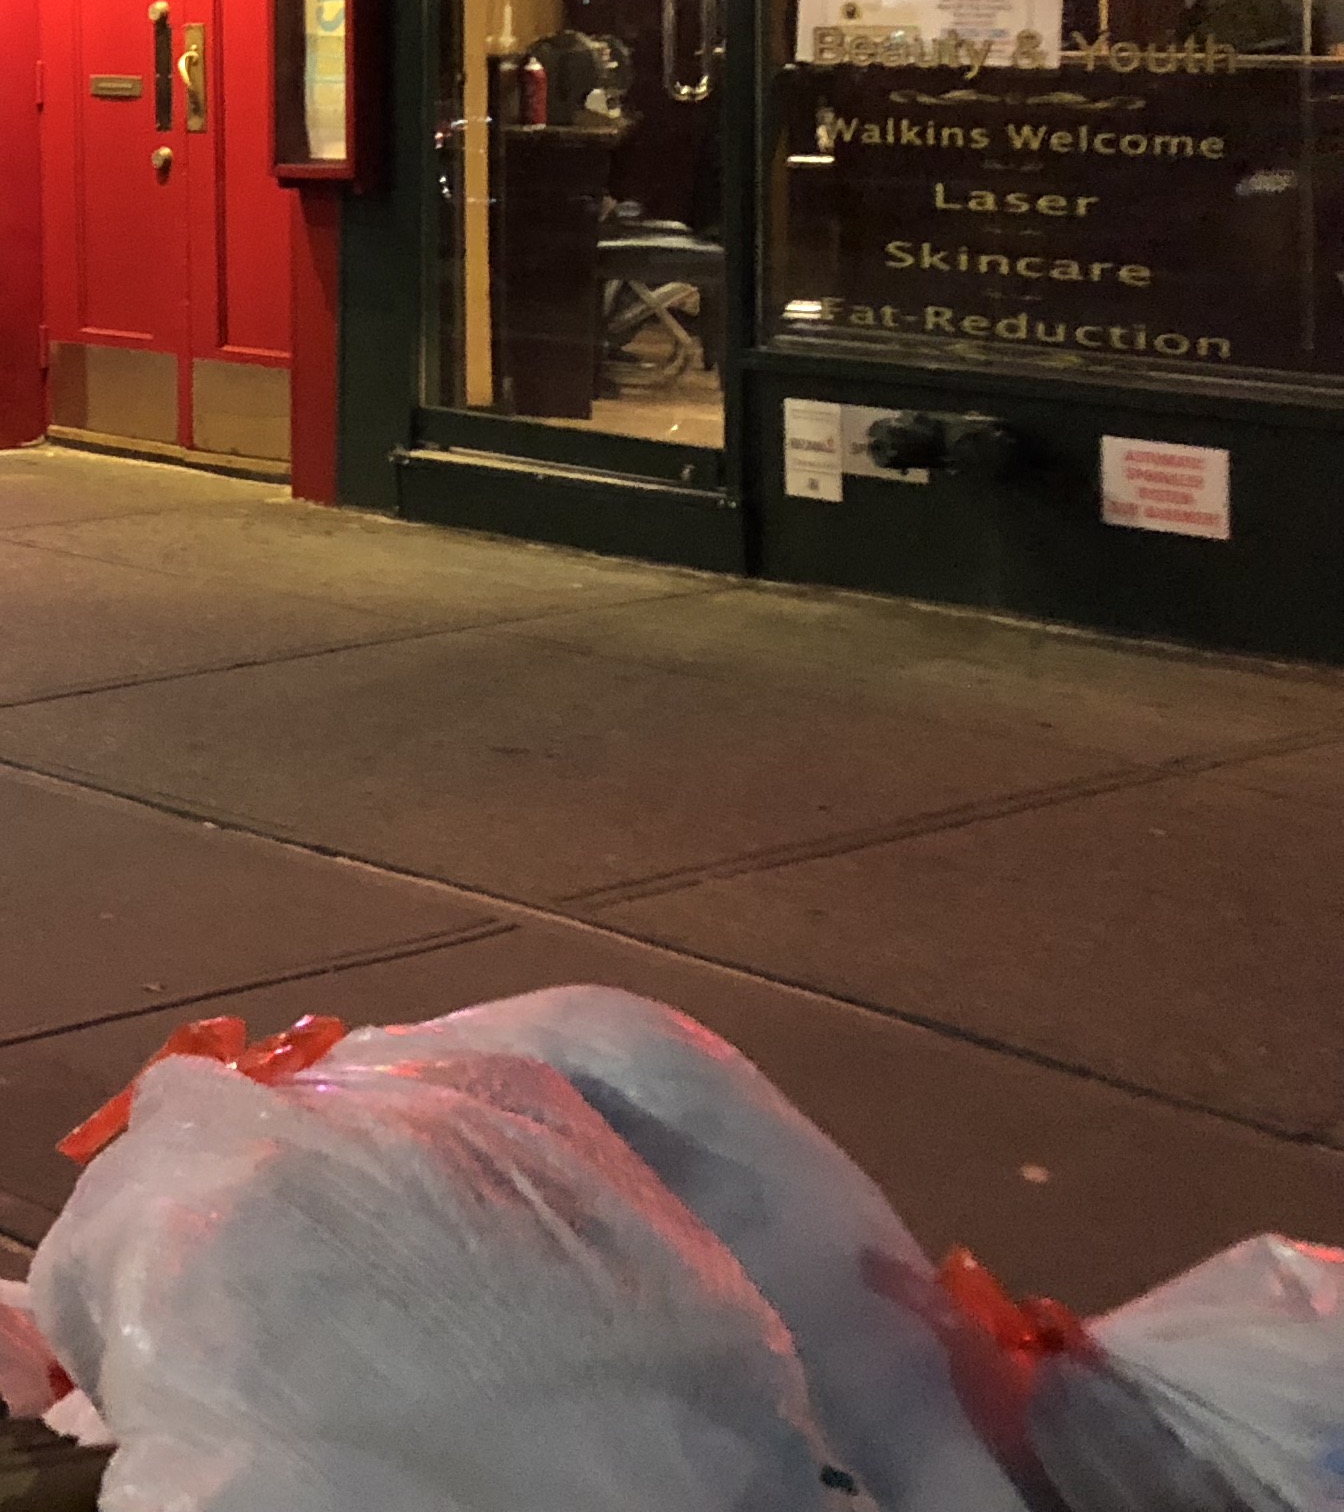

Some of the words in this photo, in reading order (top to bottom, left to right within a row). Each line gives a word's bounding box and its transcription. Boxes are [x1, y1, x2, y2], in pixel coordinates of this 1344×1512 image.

[813, 26, 992, 80] Beauty
[1012, 28, 1048, 69] &
[1069, 31, 1236, 74] Youth
[821, 116, 990, 149] Walkins
[1007, 124, 1225, 159] Welcome
[934, 182, 1099, 217] Laser
[883, 240, 1152, 287] Skincare
[820, 296, 1232, 359] Fat-Reduction
